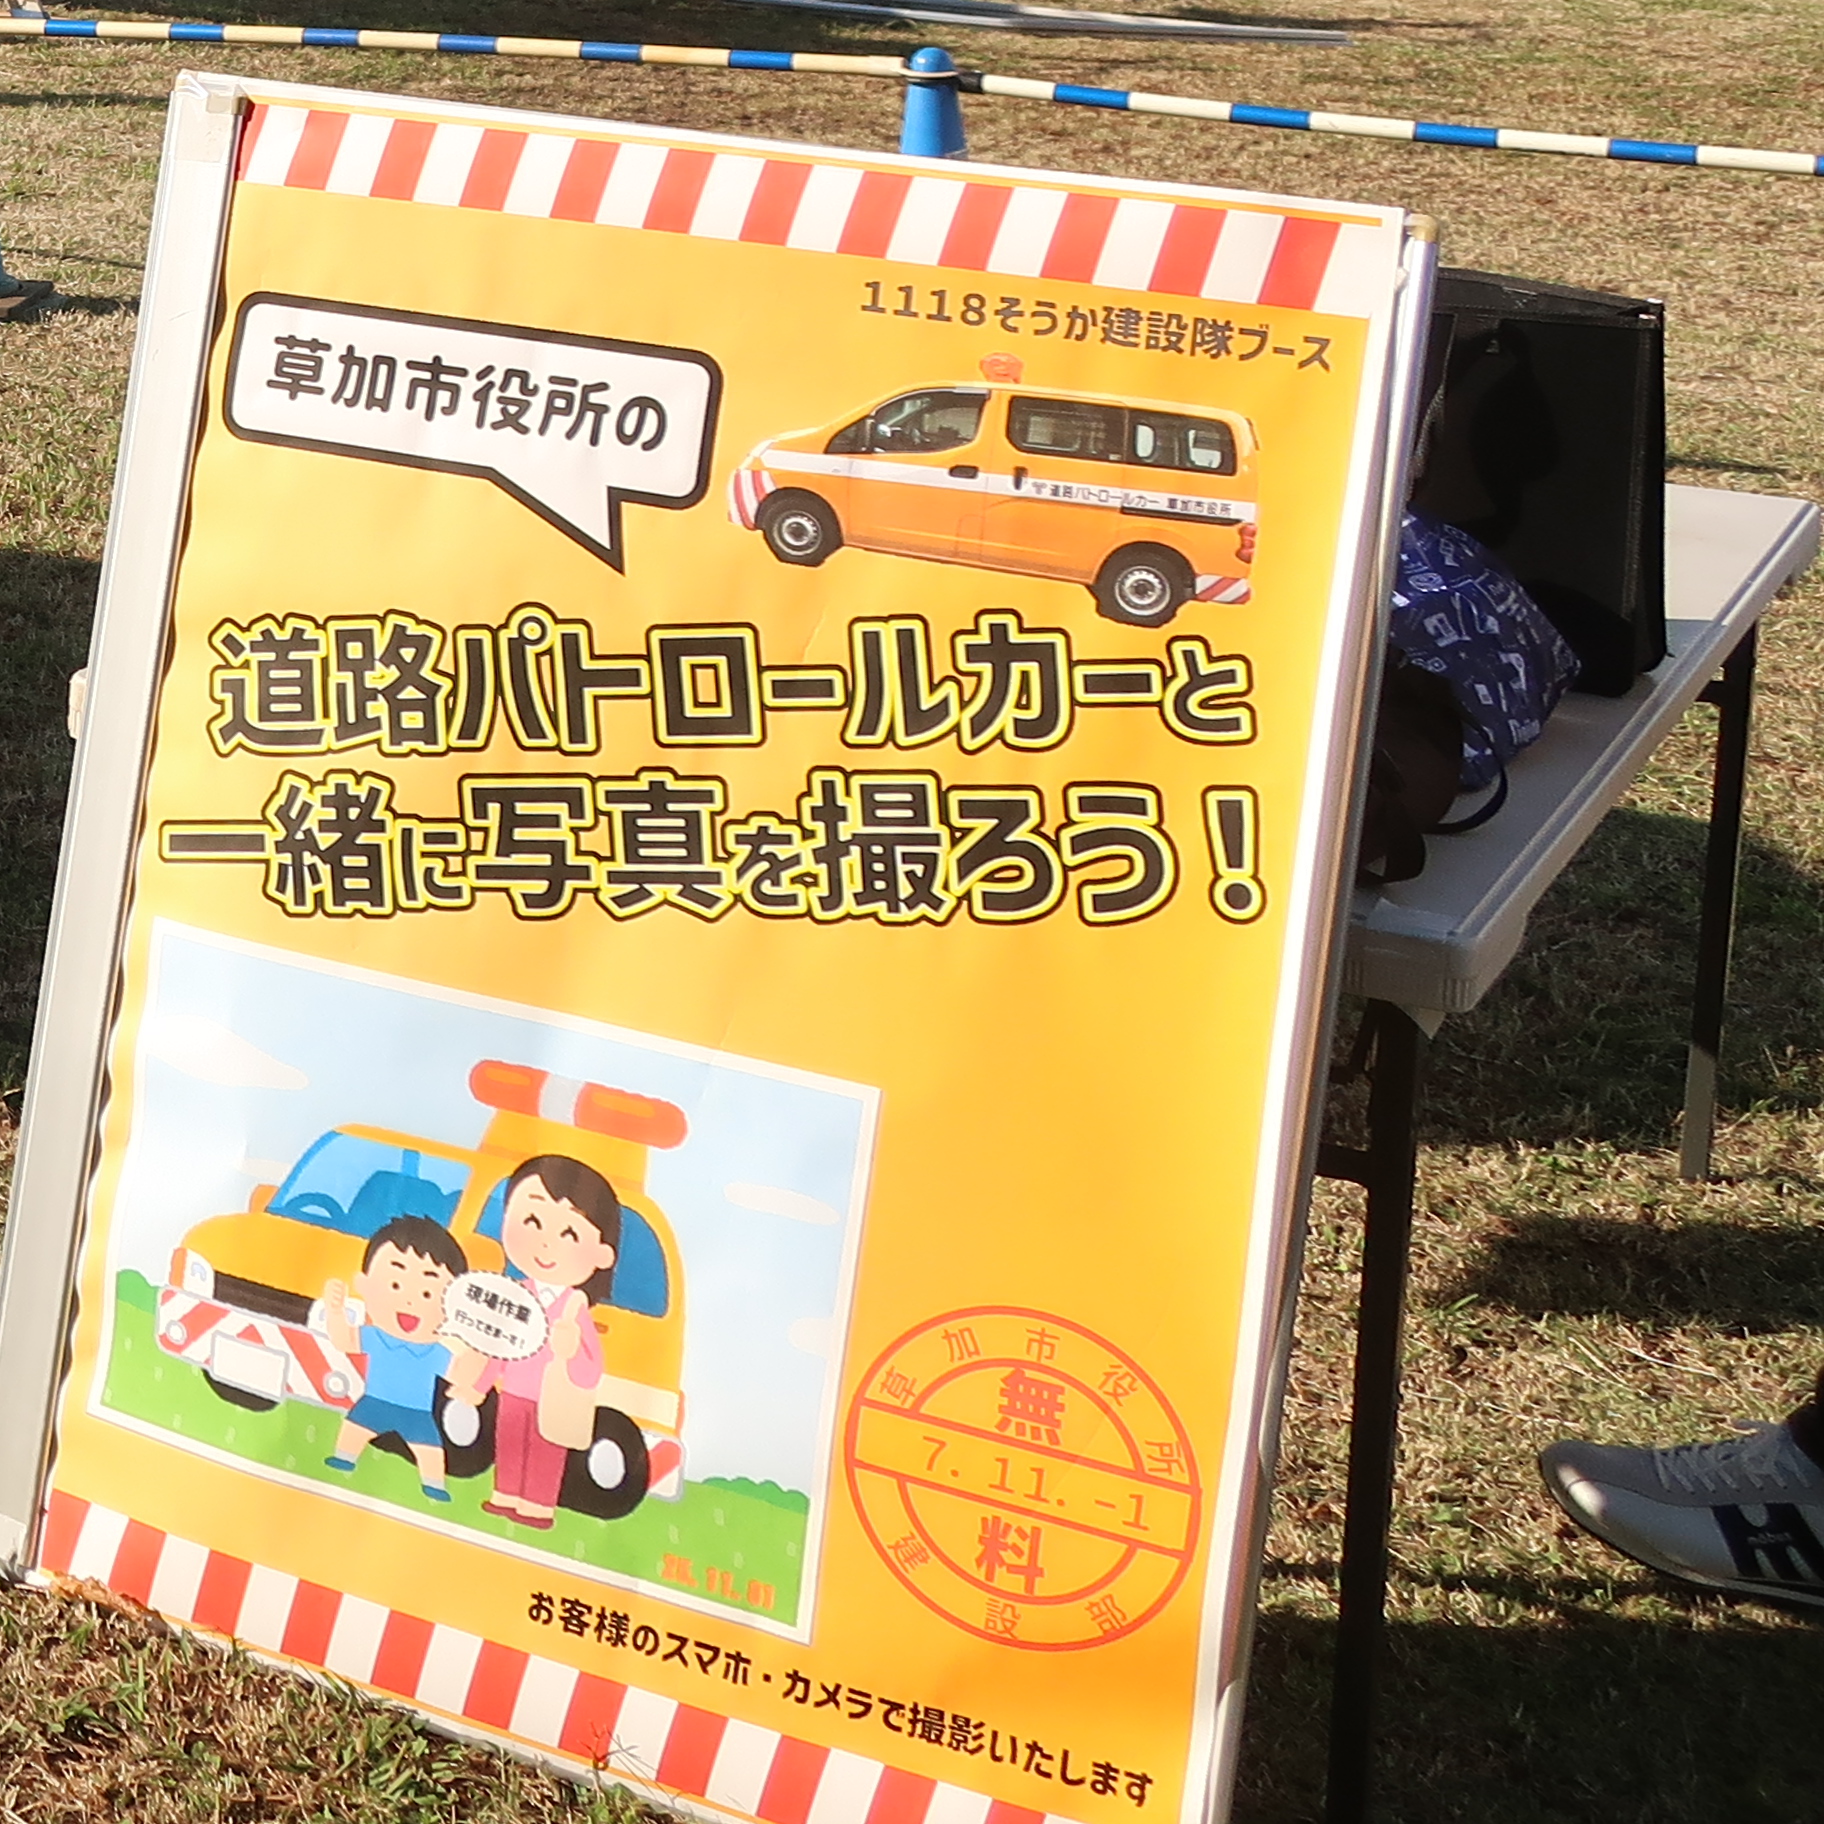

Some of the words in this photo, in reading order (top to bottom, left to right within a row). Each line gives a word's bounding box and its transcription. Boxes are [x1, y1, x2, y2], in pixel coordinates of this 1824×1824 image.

[860, 278, 1331, 373] 1118そうか建設隊ブース
[268, 334, 669, 453] 草加市役所の
[209, 601, 1255, 753] 道路パトロールカーと
[465, 1282, 532, 1325] 現場作業
[526, 1590, 1154, 1808] お客様のスマホ・カメラで撮影いたします
